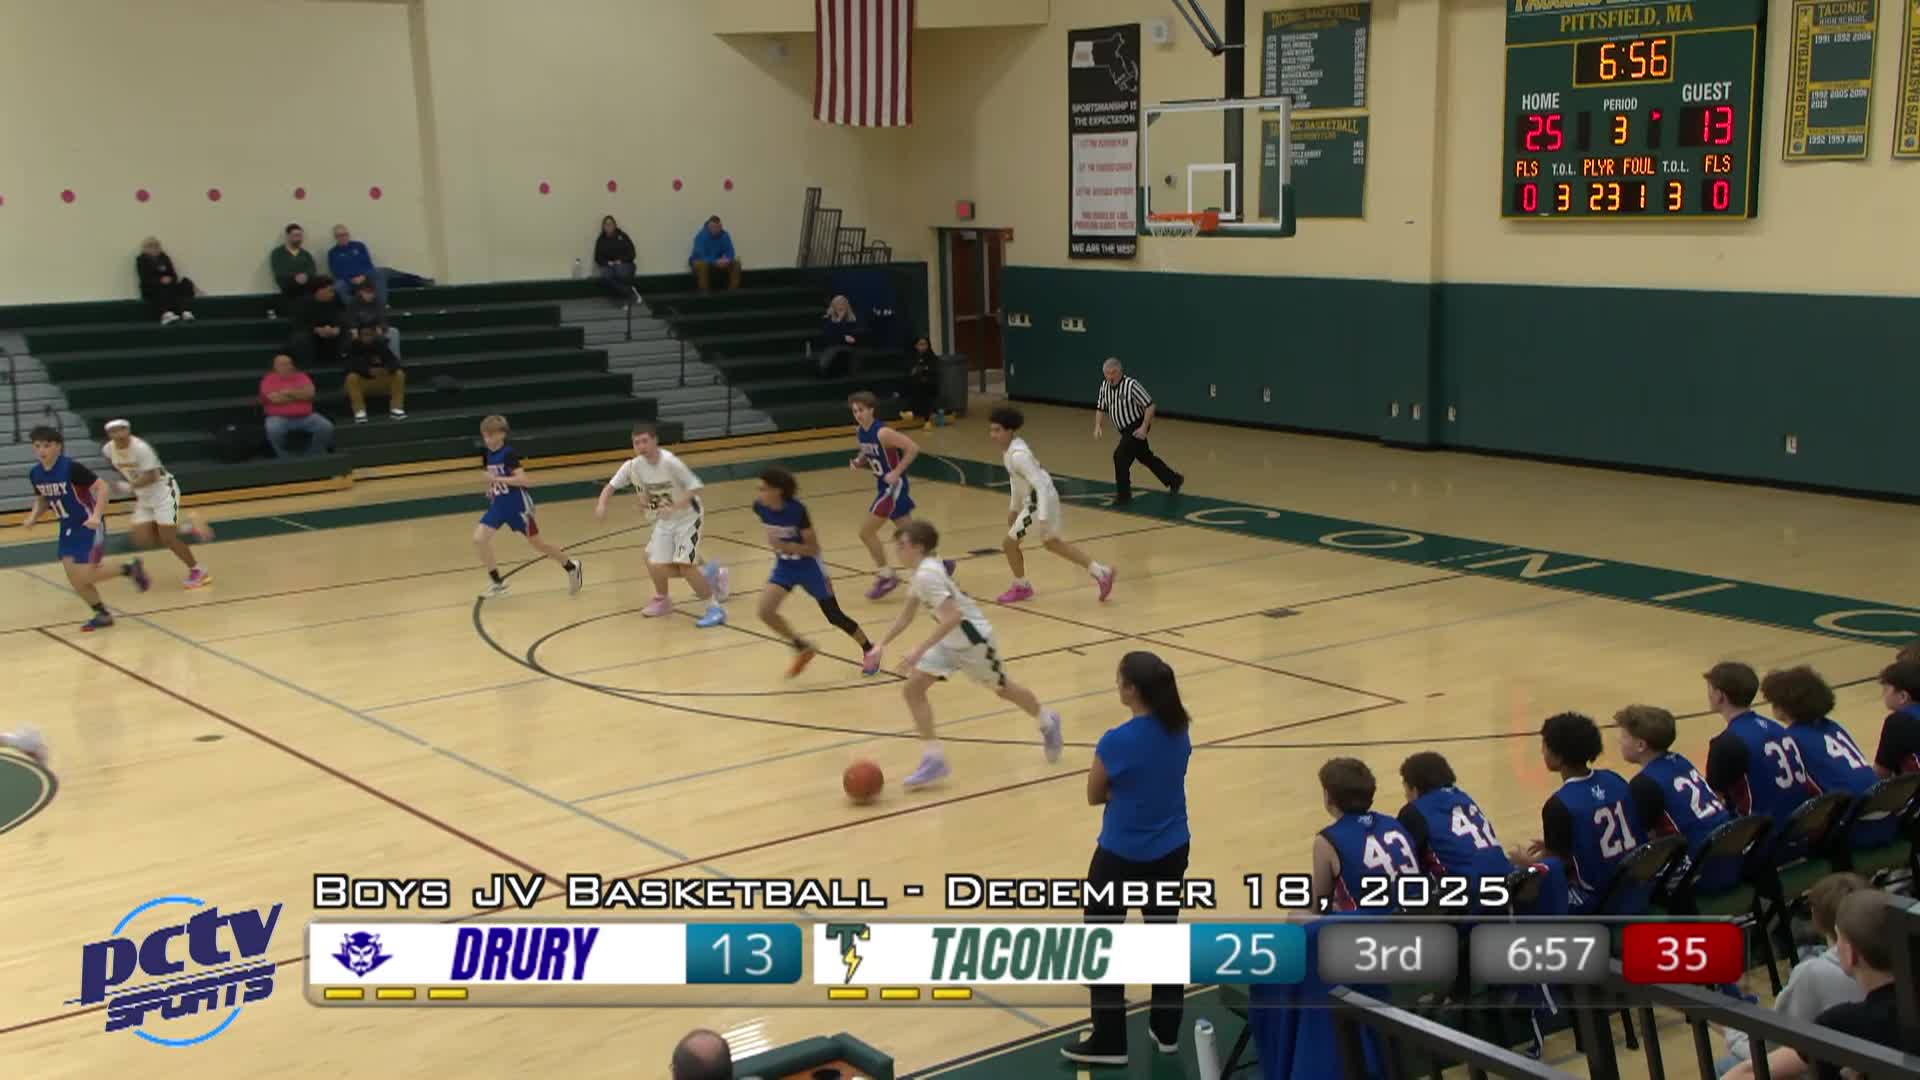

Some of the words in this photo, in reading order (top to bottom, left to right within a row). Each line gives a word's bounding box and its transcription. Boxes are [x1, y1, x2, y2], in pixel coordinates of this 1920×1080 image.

[1667, 4, 1694, 24] MA
[1600, 39, 1668, 80] 6:56
[1522, 92, 1560, 110] HOME
[1603, 98, 1638, 111] PERIOD
[1682, 82, 1732, 102] GUEST
[1525, 114, 1563, 151] 25
[1613, 115, 1628, 145] 3
[1703, 106, 1734, 144] 13
[1516, 160, 1538, 177] FLS
[1552, 163, 1576, 176] T.O.L.
[1583, 159, 1615, 177] PLYR
[1623, 157, 1655, 175] FOUL
[1662, 160, 1689, 173] T.O.L.
[1705, 154, 1731, 173] FLS
[1523, 183, 1537, 212] 0
[1557, 183, 1570, 211] 3
[1589, 182, 1620, 211] 23
[1640, 184, 1646, 209] 1
[1668, 181, 1682, 211] 3
[1713, 180, 1729, 211] 0
[1764, 736, 1809, 790] 33
[1824, 730, 1869, 769] 41
[1593, 801, 1637, 859] 21
[1363, 830, 1420, 881] 43
